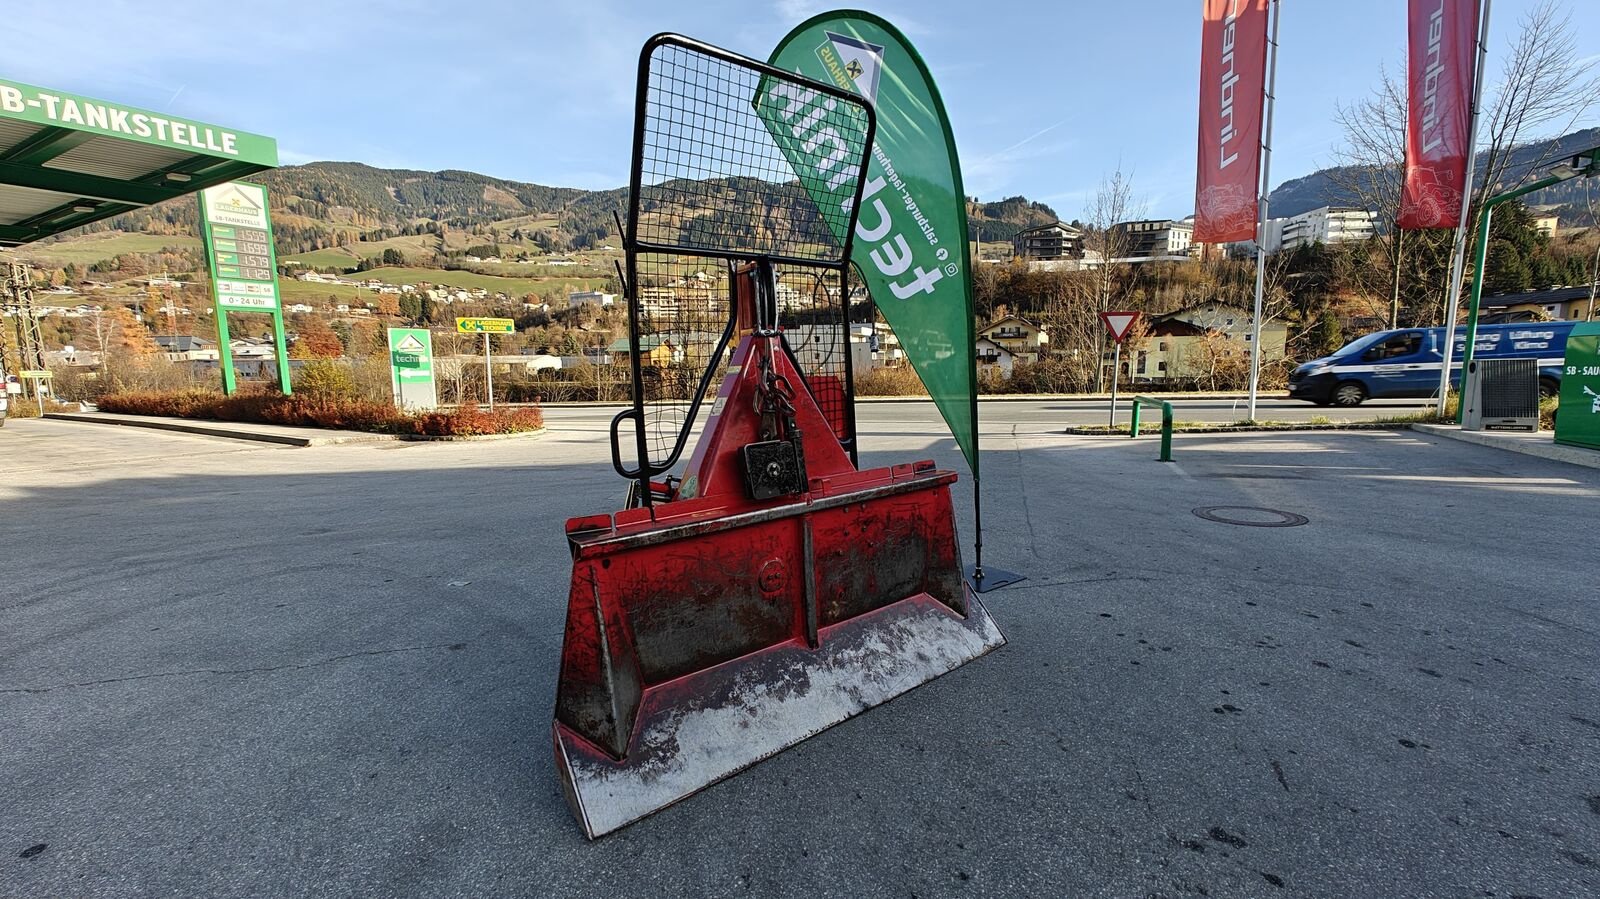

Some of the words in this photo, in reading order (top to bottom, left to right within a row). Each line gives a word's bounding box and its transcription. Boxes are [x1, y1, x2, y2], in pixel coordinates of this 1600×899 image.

[215, 215, 261, 226] SB-TANKSTELLE
[240, 297, 251, 305] 24
[1566, 366, 1577, 375] SB
[1583, 366, 1600, 376] SAU
